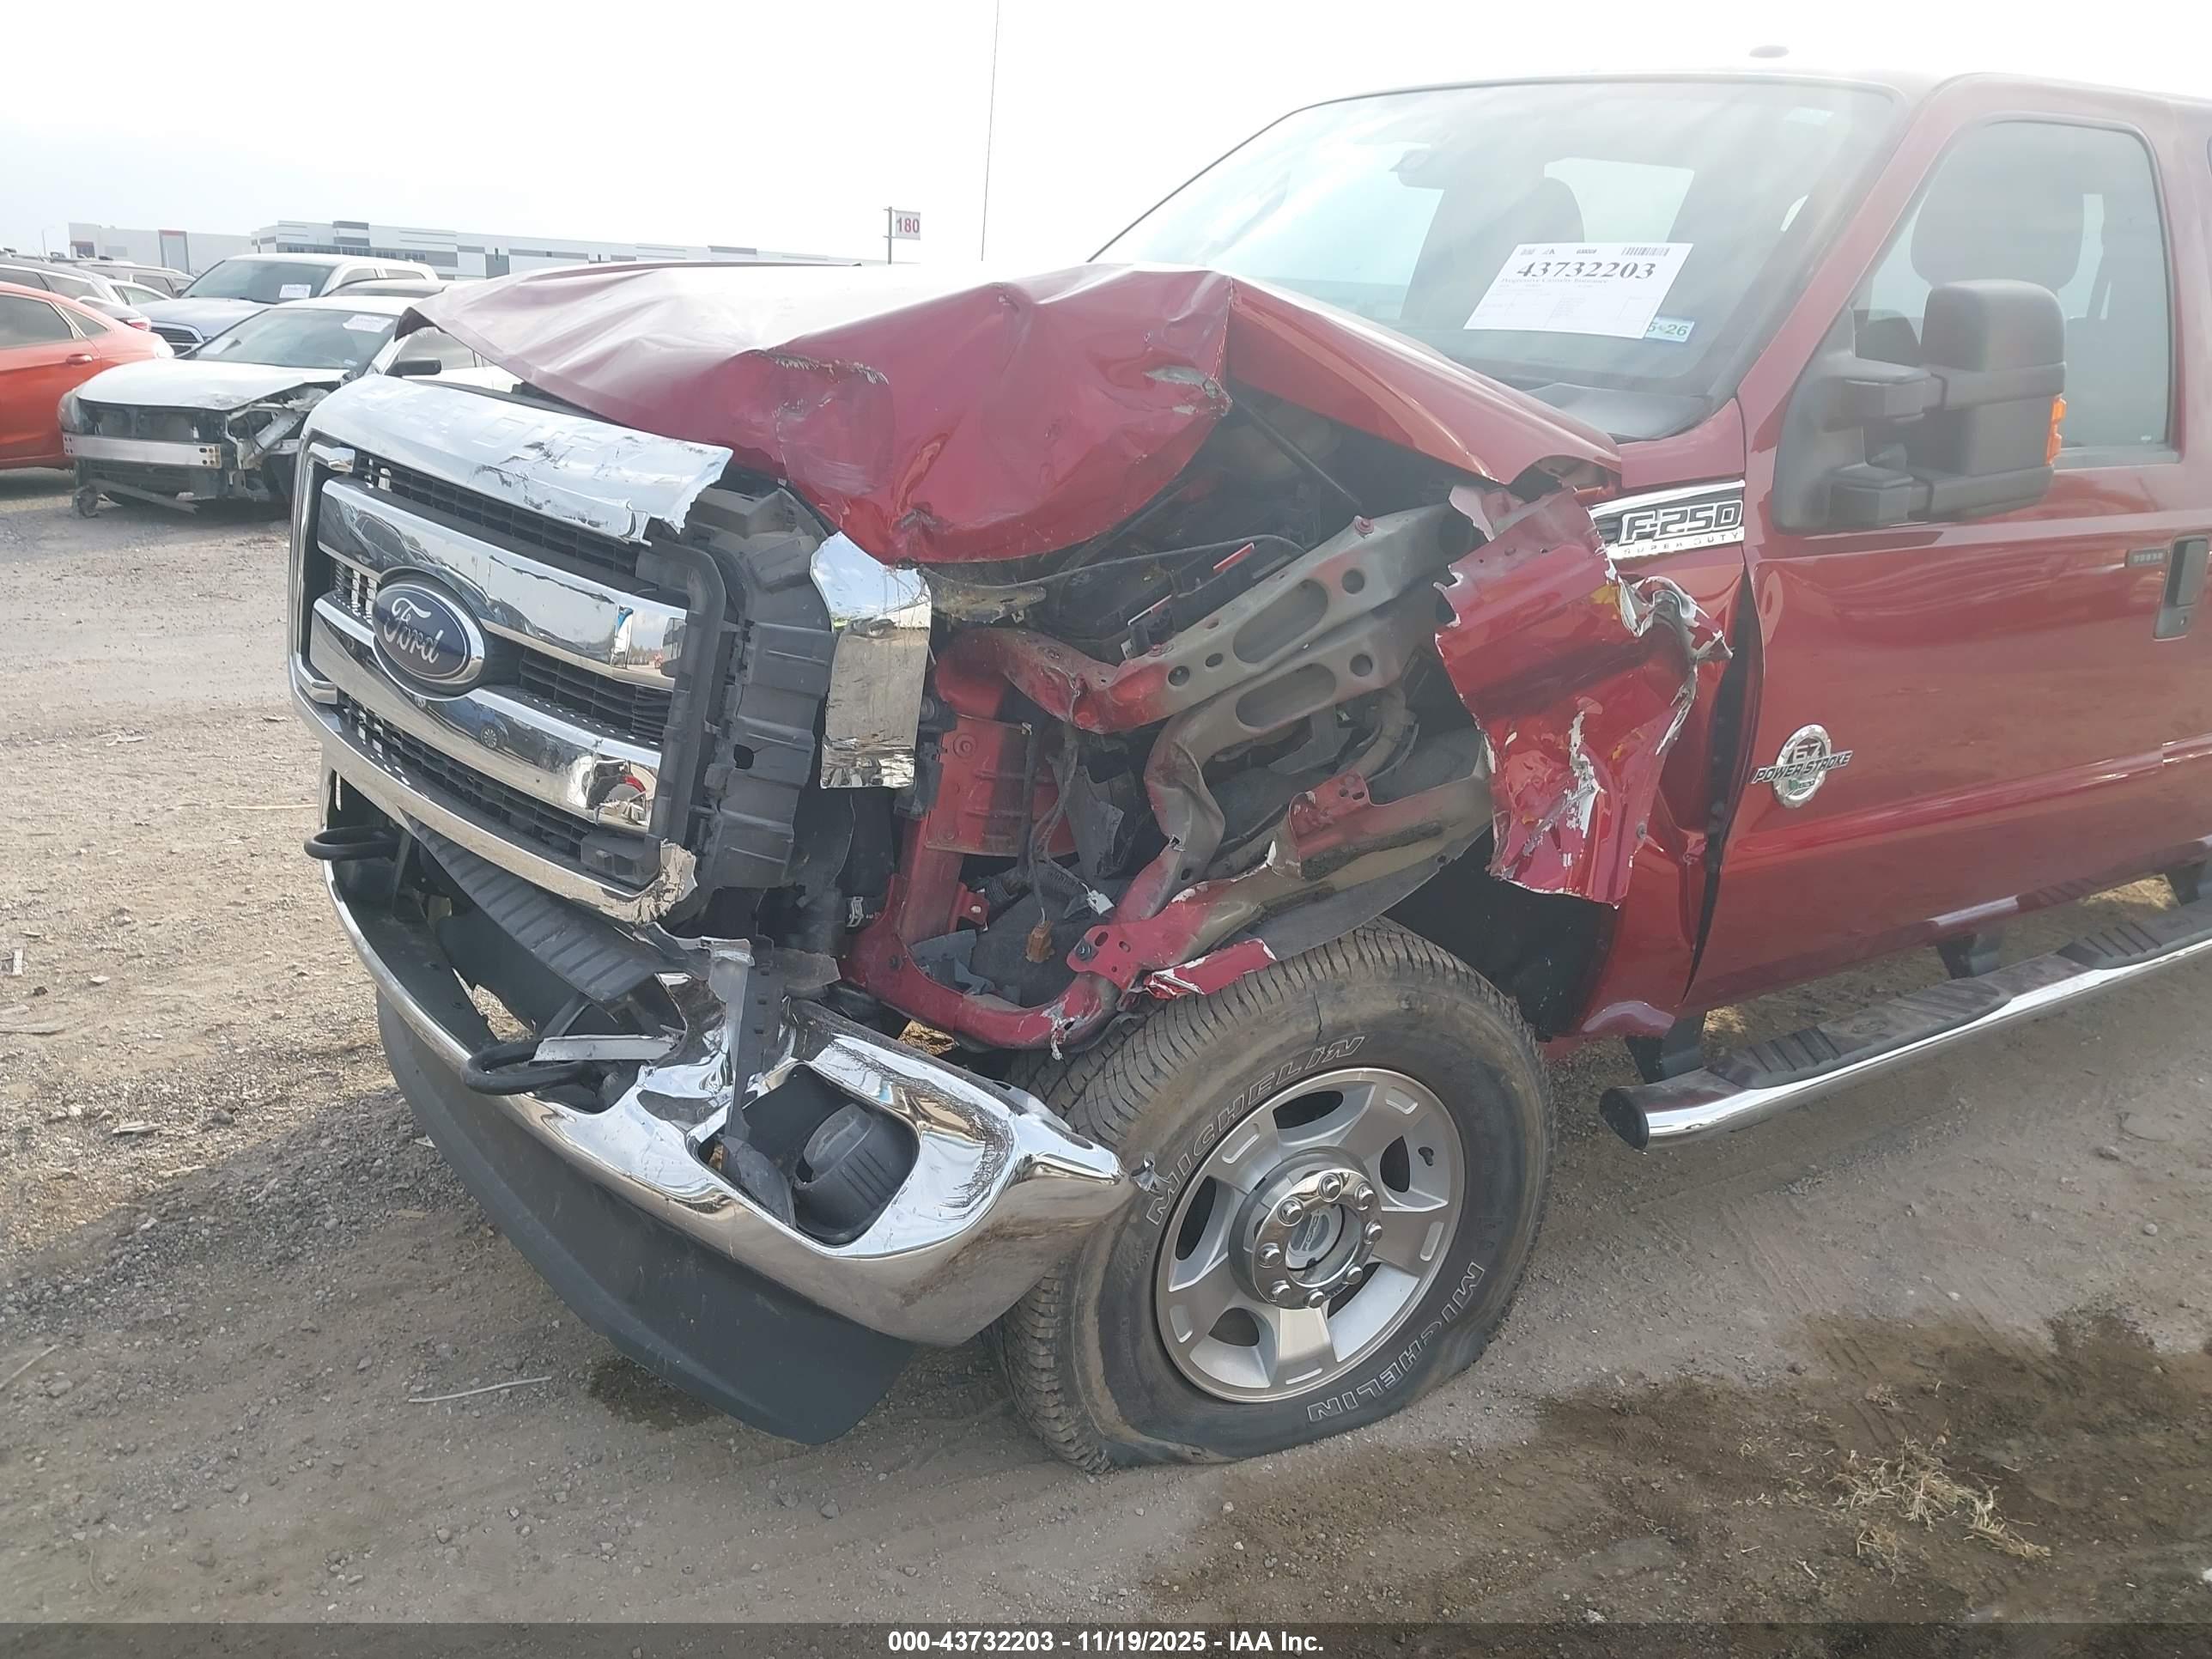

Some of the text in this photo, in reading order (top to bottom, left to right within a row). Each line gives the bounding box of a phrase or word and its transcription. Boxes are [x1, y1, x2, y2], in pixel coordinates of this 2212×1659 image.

[896, 216, 921, 234] 180
[1516, 261, 1656, 279] 43732203
[1619, 500, 1743, 546] F-250
[1692, 532, 1740, 546] DUTY
[383, 597, 445, 664] Ford
[1753, 750, 1852, 784] POWER STROKE
[1146, 1036, 1365, 1225] MICHELIN
[1306, 1261, 1486, 1423] MICHELIN
